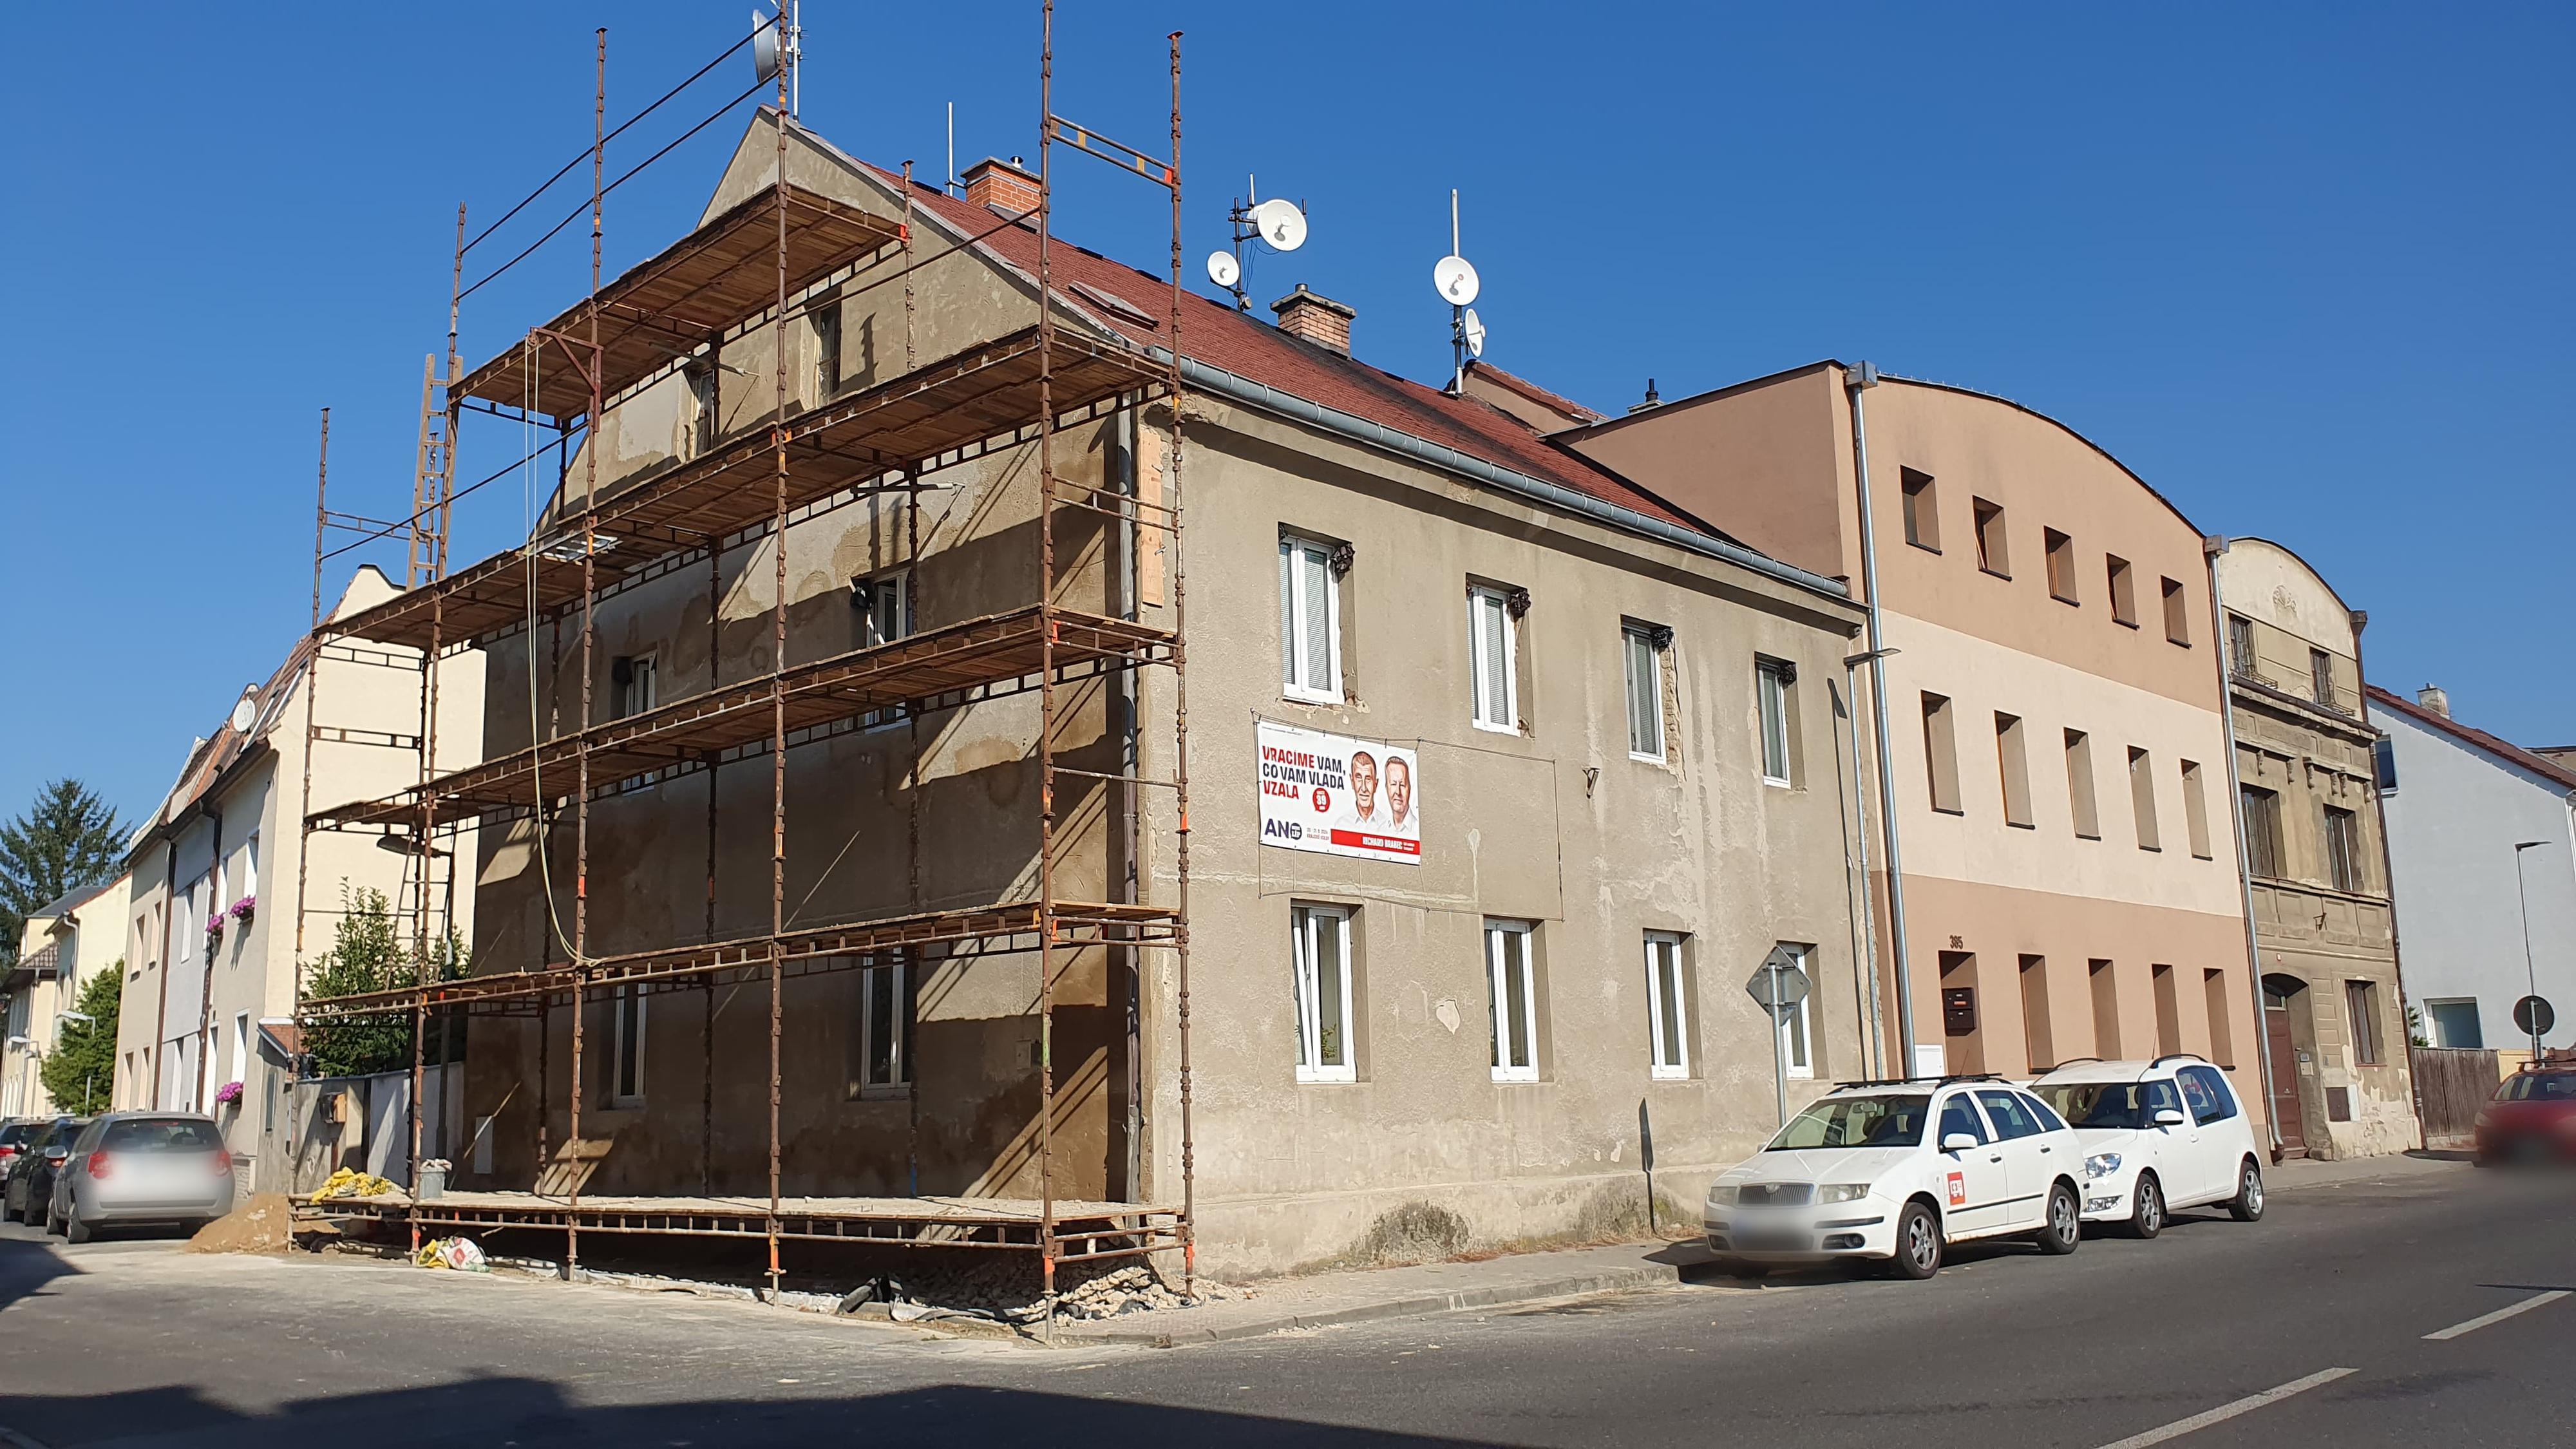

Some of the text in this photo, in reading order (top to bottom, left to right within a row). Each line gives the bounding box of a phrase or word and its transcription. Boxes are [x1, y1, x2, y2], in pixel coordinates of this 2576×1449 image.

[1262, 745, 1314, 768] VRACÍME
[1263, 762, 1278, 779] CO
[1280, 765, 1306, 784] VÁM
[1263, 779, 1299, 799] VZALA
[1264, 818, 1302, 840] ANO
